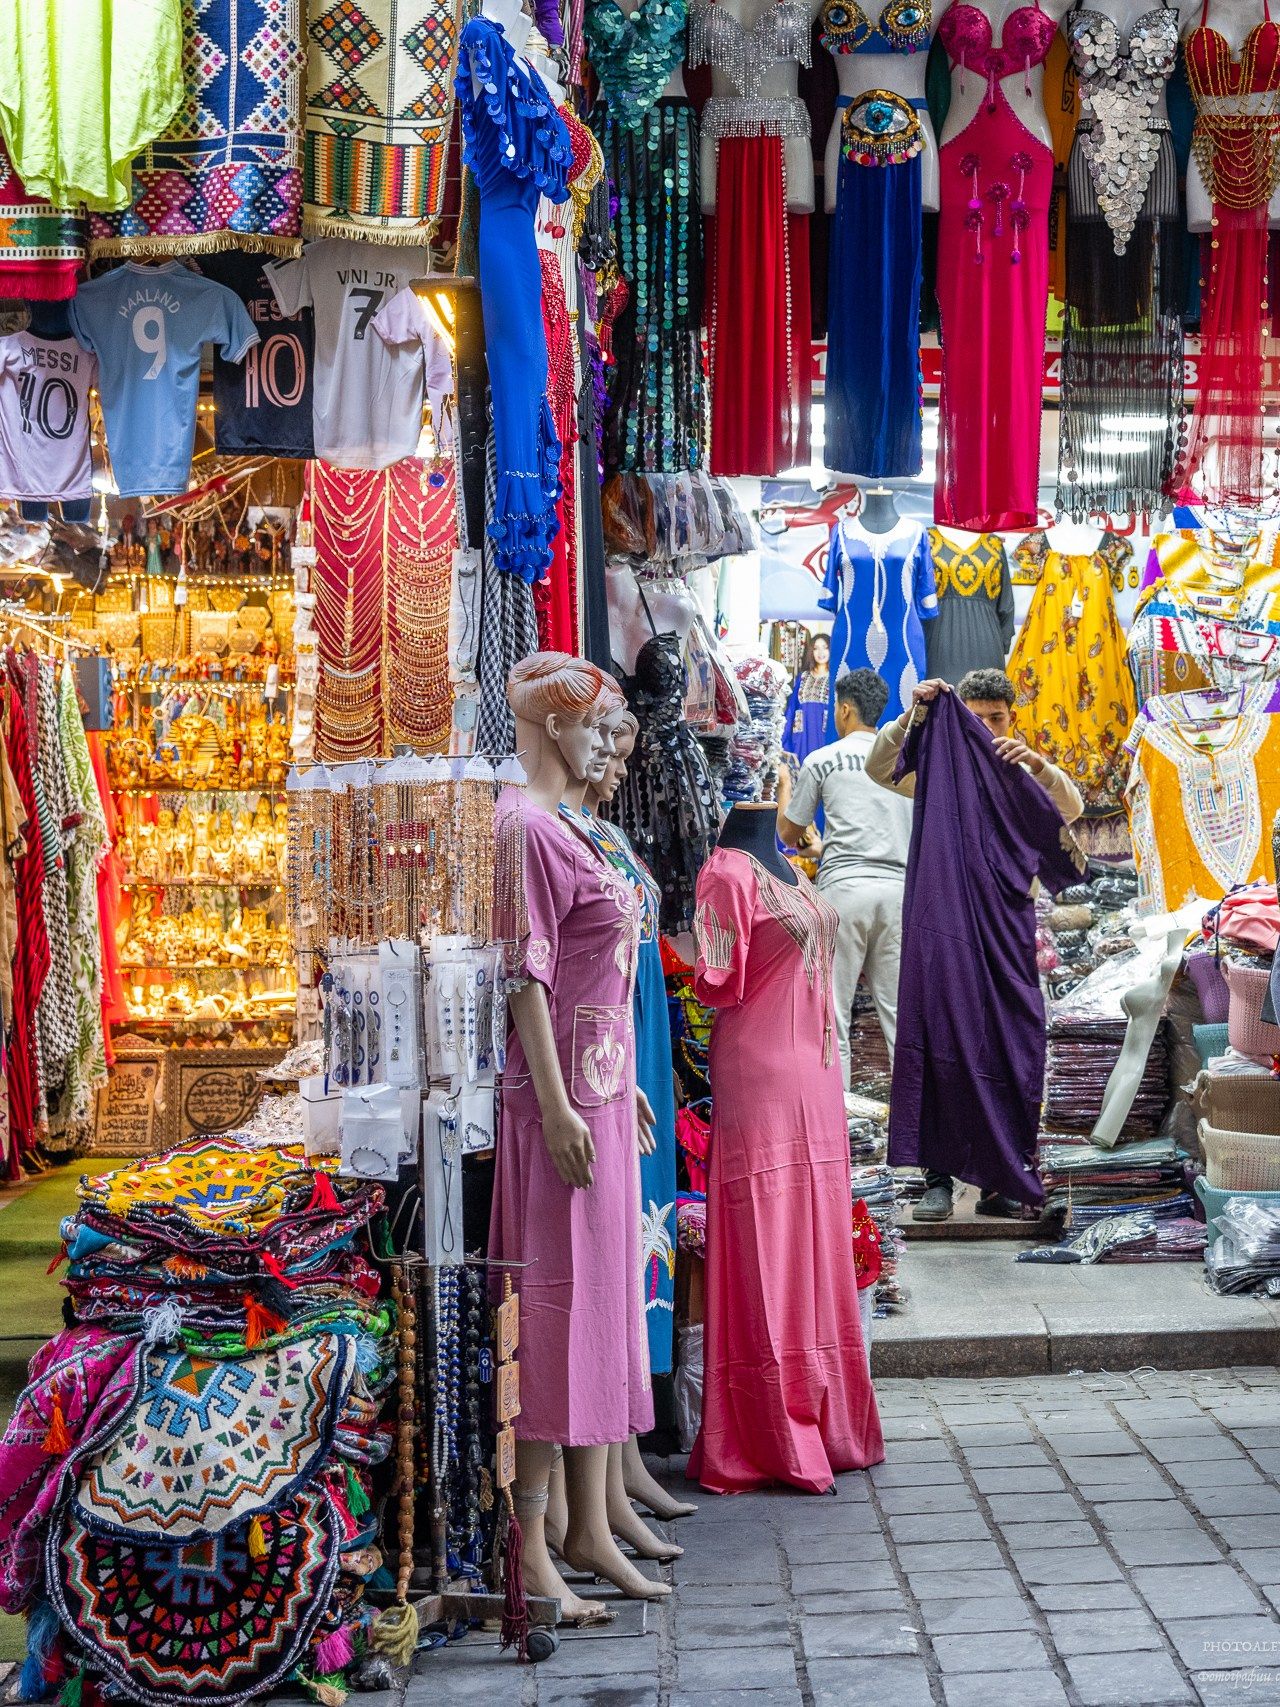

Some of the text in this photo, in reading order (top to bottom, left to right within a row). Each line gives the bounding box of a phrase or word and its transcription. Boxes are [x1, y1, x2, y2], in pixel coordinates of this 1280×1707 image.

[117, 288, 181, 319] HAALAND
[348, 287, 385, 340] 7
[21, 346, 79, 374] MESSI
[131, 306, 167, 380] 9
[246, 333, 306, 408] 10
[18, 372, 78, 439] 10
